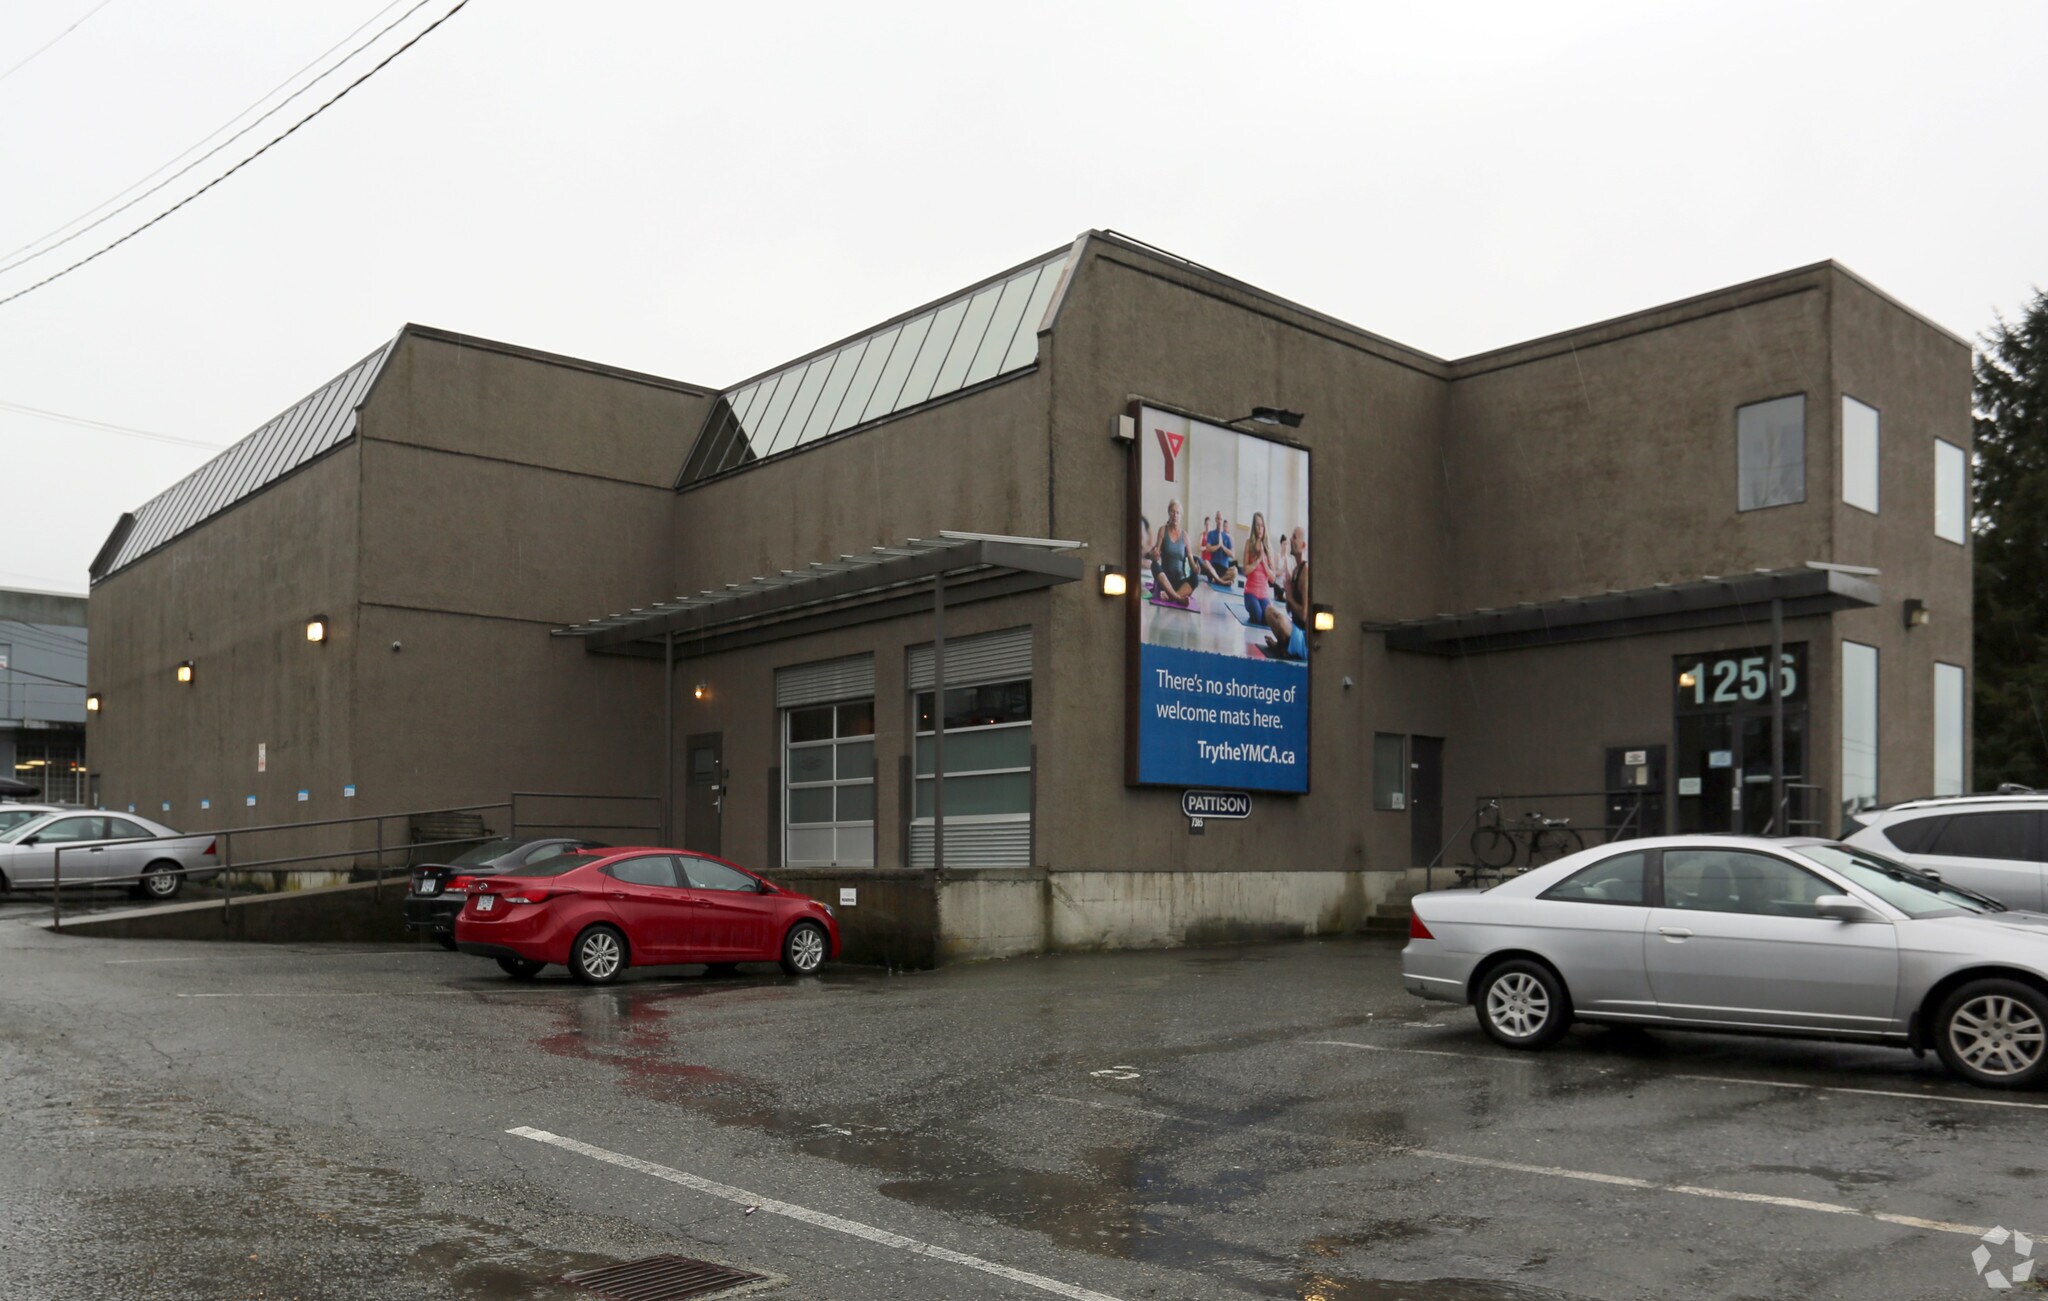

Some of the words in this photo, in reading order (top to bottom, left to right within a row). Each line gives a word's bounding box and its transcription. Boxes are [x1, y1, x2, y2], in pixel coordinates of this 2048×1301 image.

[1206, 680, 1223, 695] no
[1226, 678, 1280, 704] shortage
[1283, 685, 1296, 703] of
[1686, 653, 1796, 704] 1256
[1156, 701, 1217, 723] welcome
[1220, 710, 1250, 726] mats
[1253, 708, 1283, 729] here.
[1197, 740, 1295, 764] TrytheYMCA.ca
[1188, 796, 1247, 812] PATTISON
